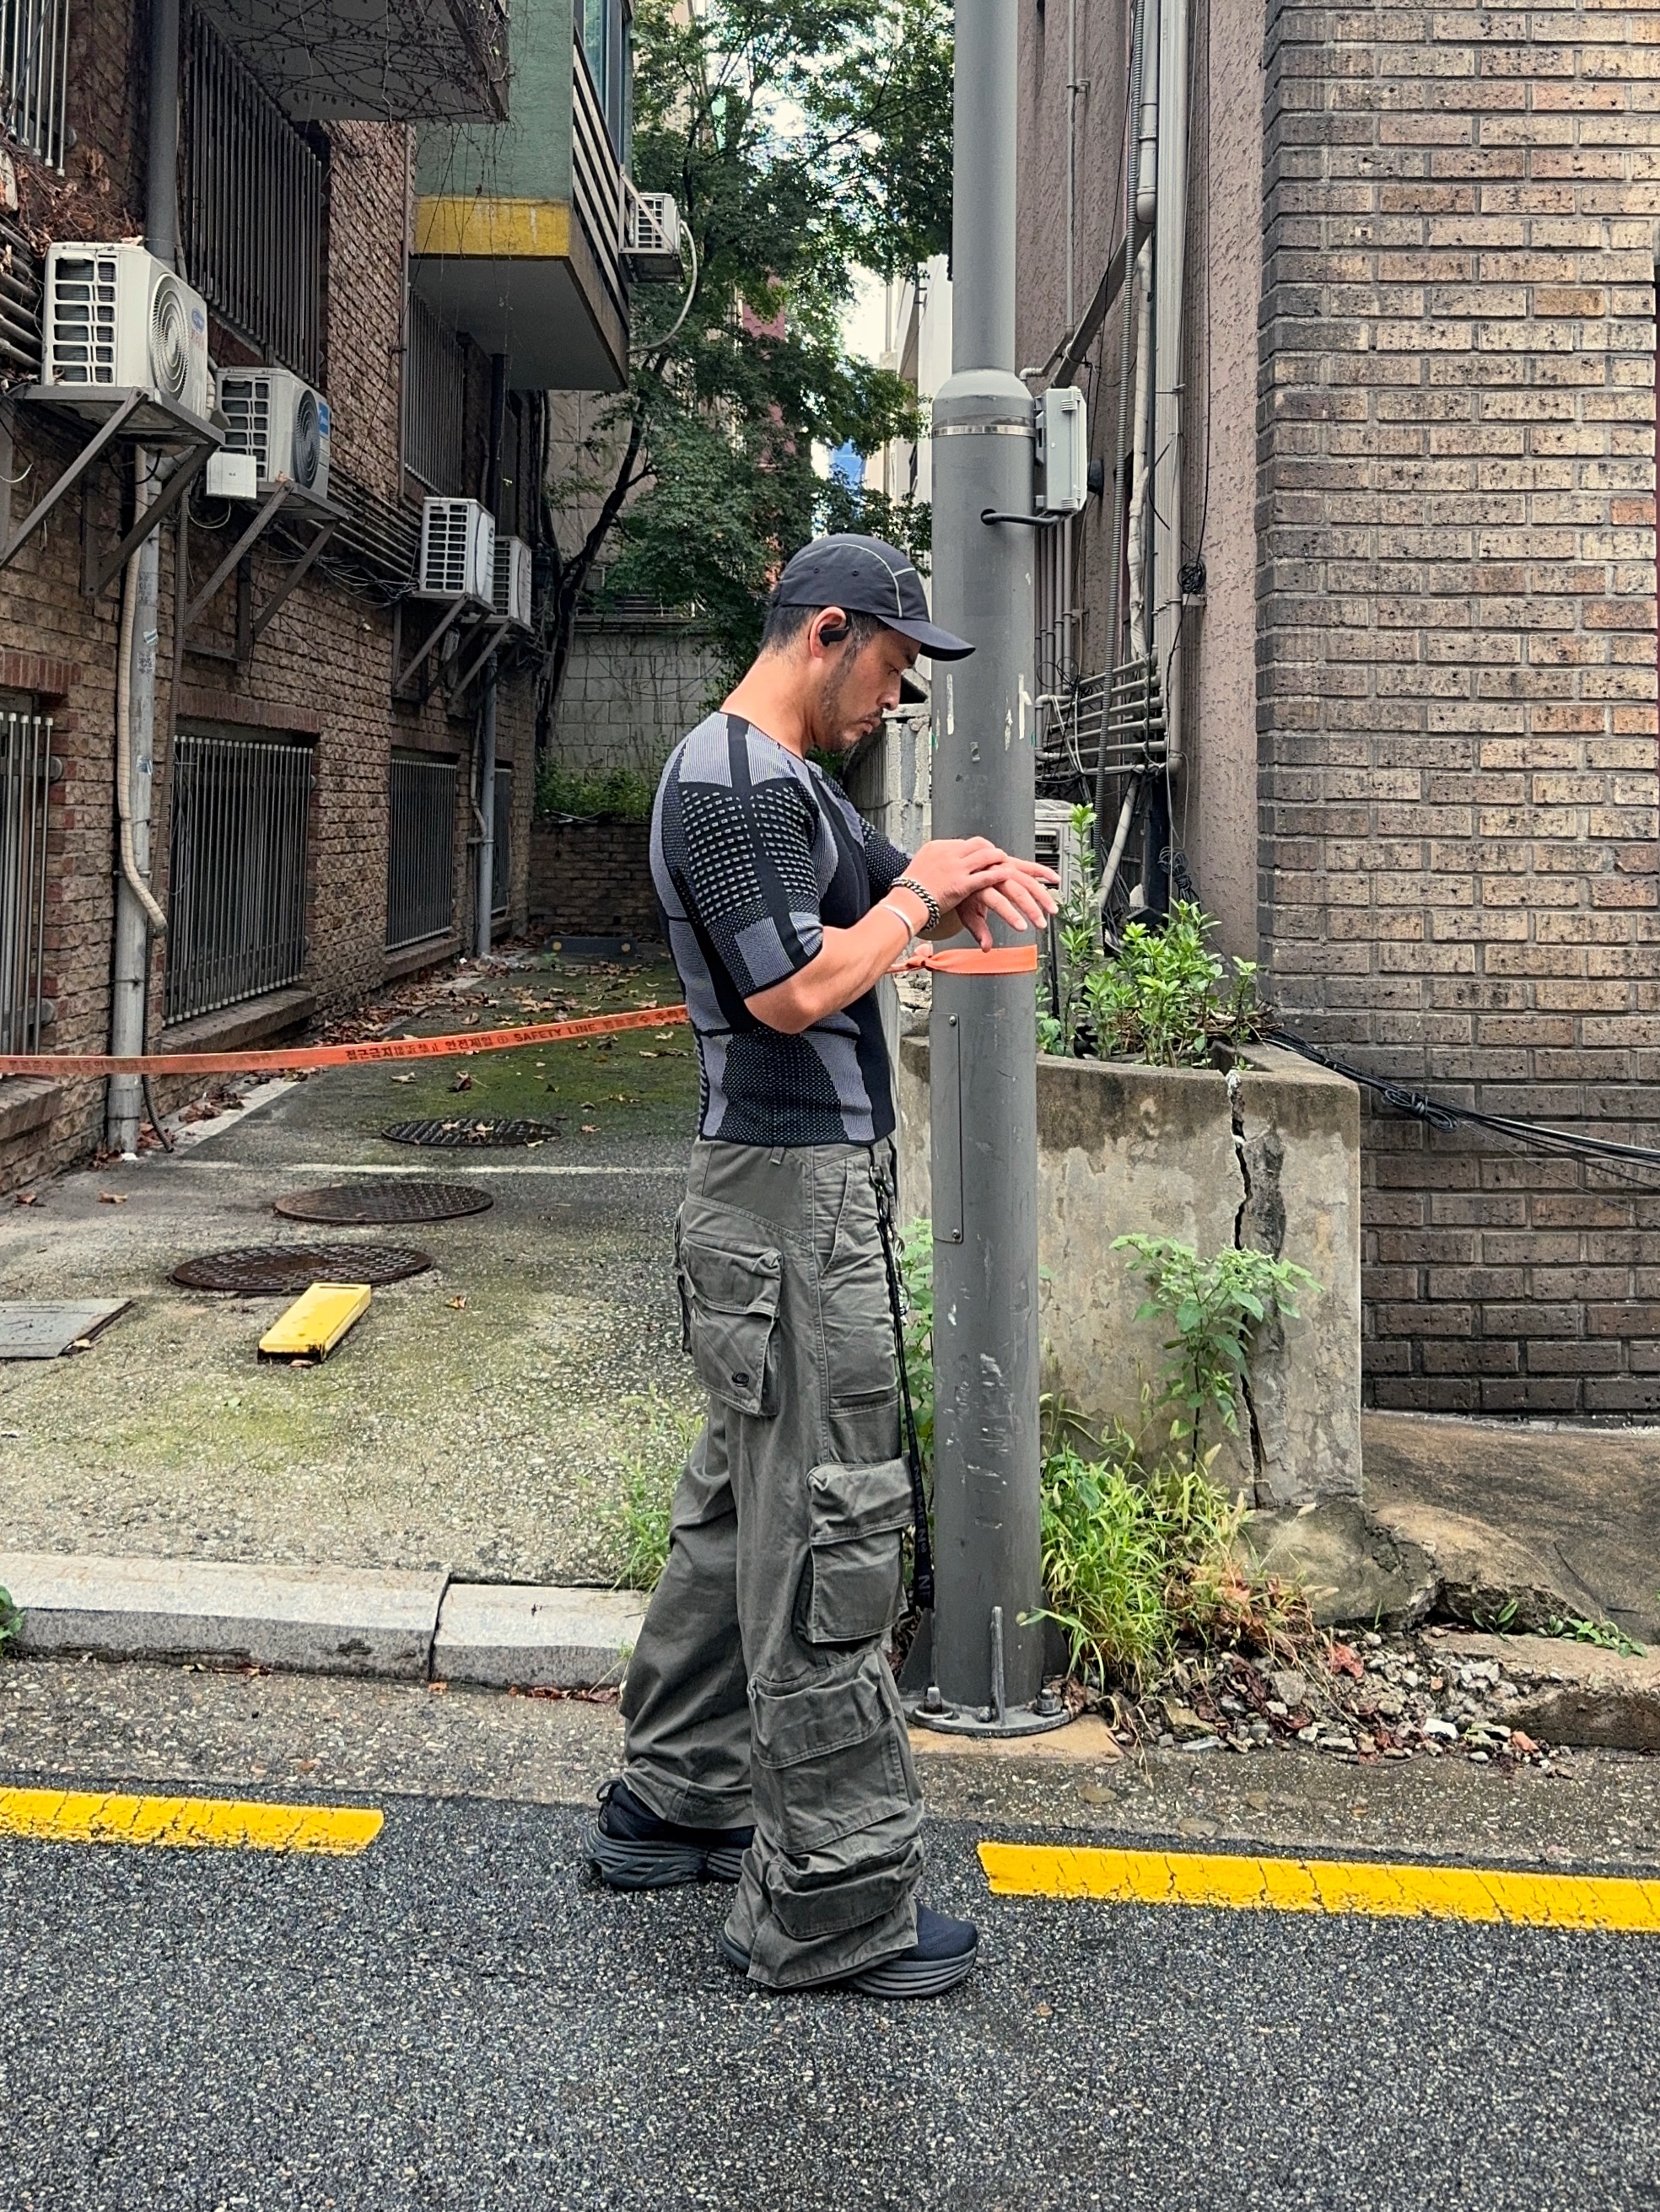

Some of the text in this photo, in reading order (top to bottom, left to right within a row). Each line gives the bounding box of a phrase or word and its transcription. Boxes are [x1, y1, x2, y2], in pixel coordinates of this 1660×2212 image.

[345, 1046, 394, 1061] 접근금지
[445, 1036, 493, 1051] 안전제일
[514, 1027, 562, 1042] SAFETY
[569, 1023, 597, 1035] LINE
